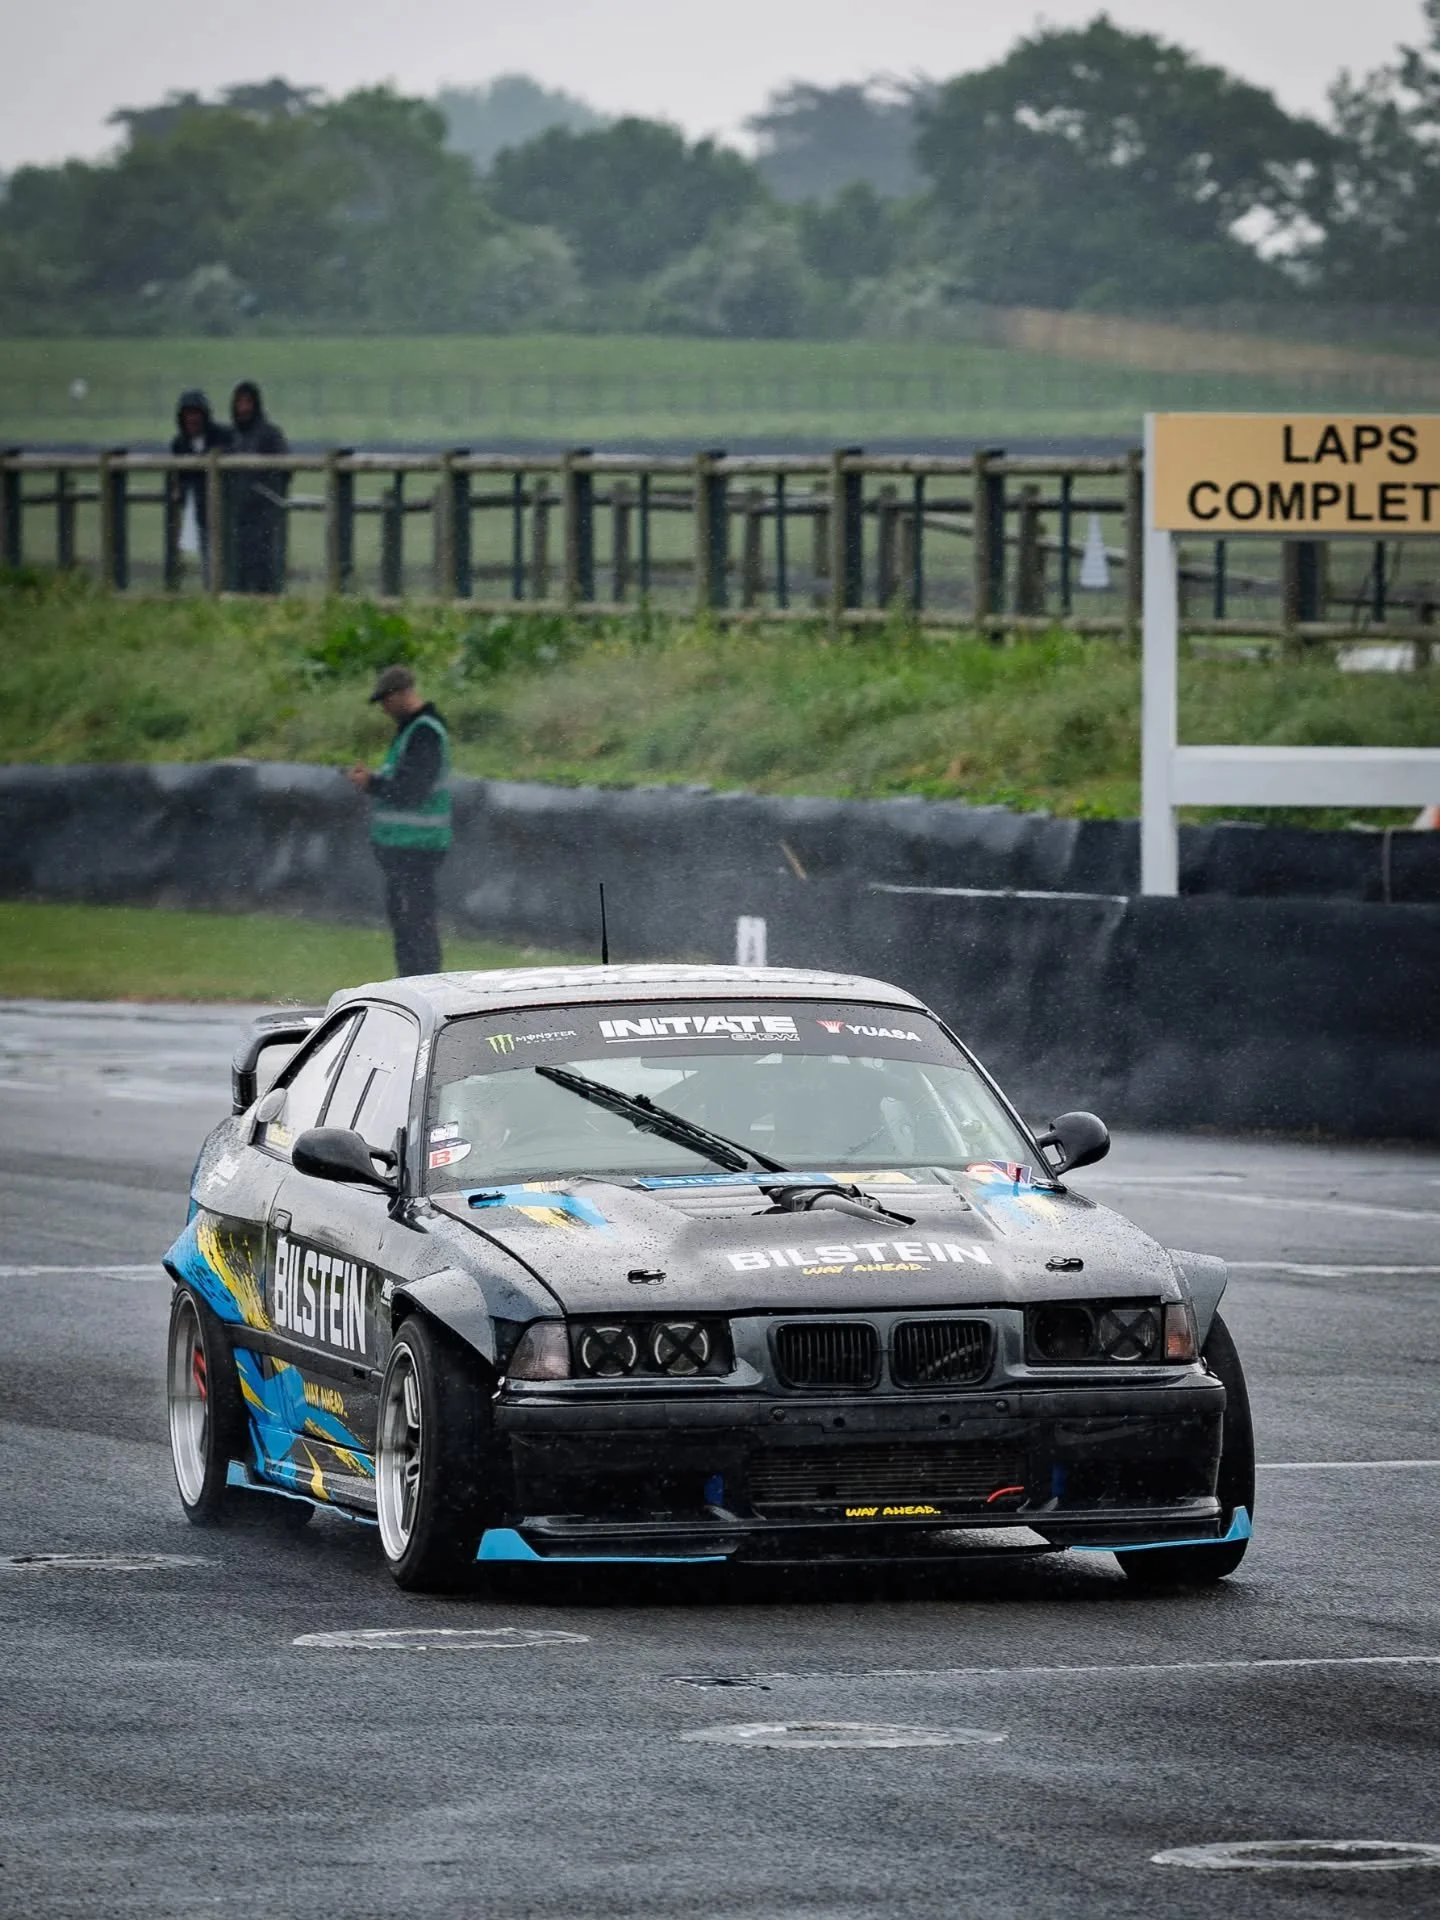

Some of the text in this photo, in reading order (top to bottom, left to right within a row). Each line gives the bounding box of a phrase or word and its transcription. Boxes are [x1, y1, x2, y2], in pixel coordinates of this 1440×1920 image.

[1284, 425, 1418, 464] LAPS
[1188, 481, 1440, 521] COMPLET
[516, 1030, 577, 1042] MONSTER
[599, 1016, 798, 1037] INITIATE
[845, 1024, 922, 1041] YUASA
[728, 1242, 993, 1271] BILSTEIN
[803, 1265, 846, 1275] WAY
[275, 1238, 367, 1354] BILSTEIN
[845, 1507, 879, 1517] WAY
